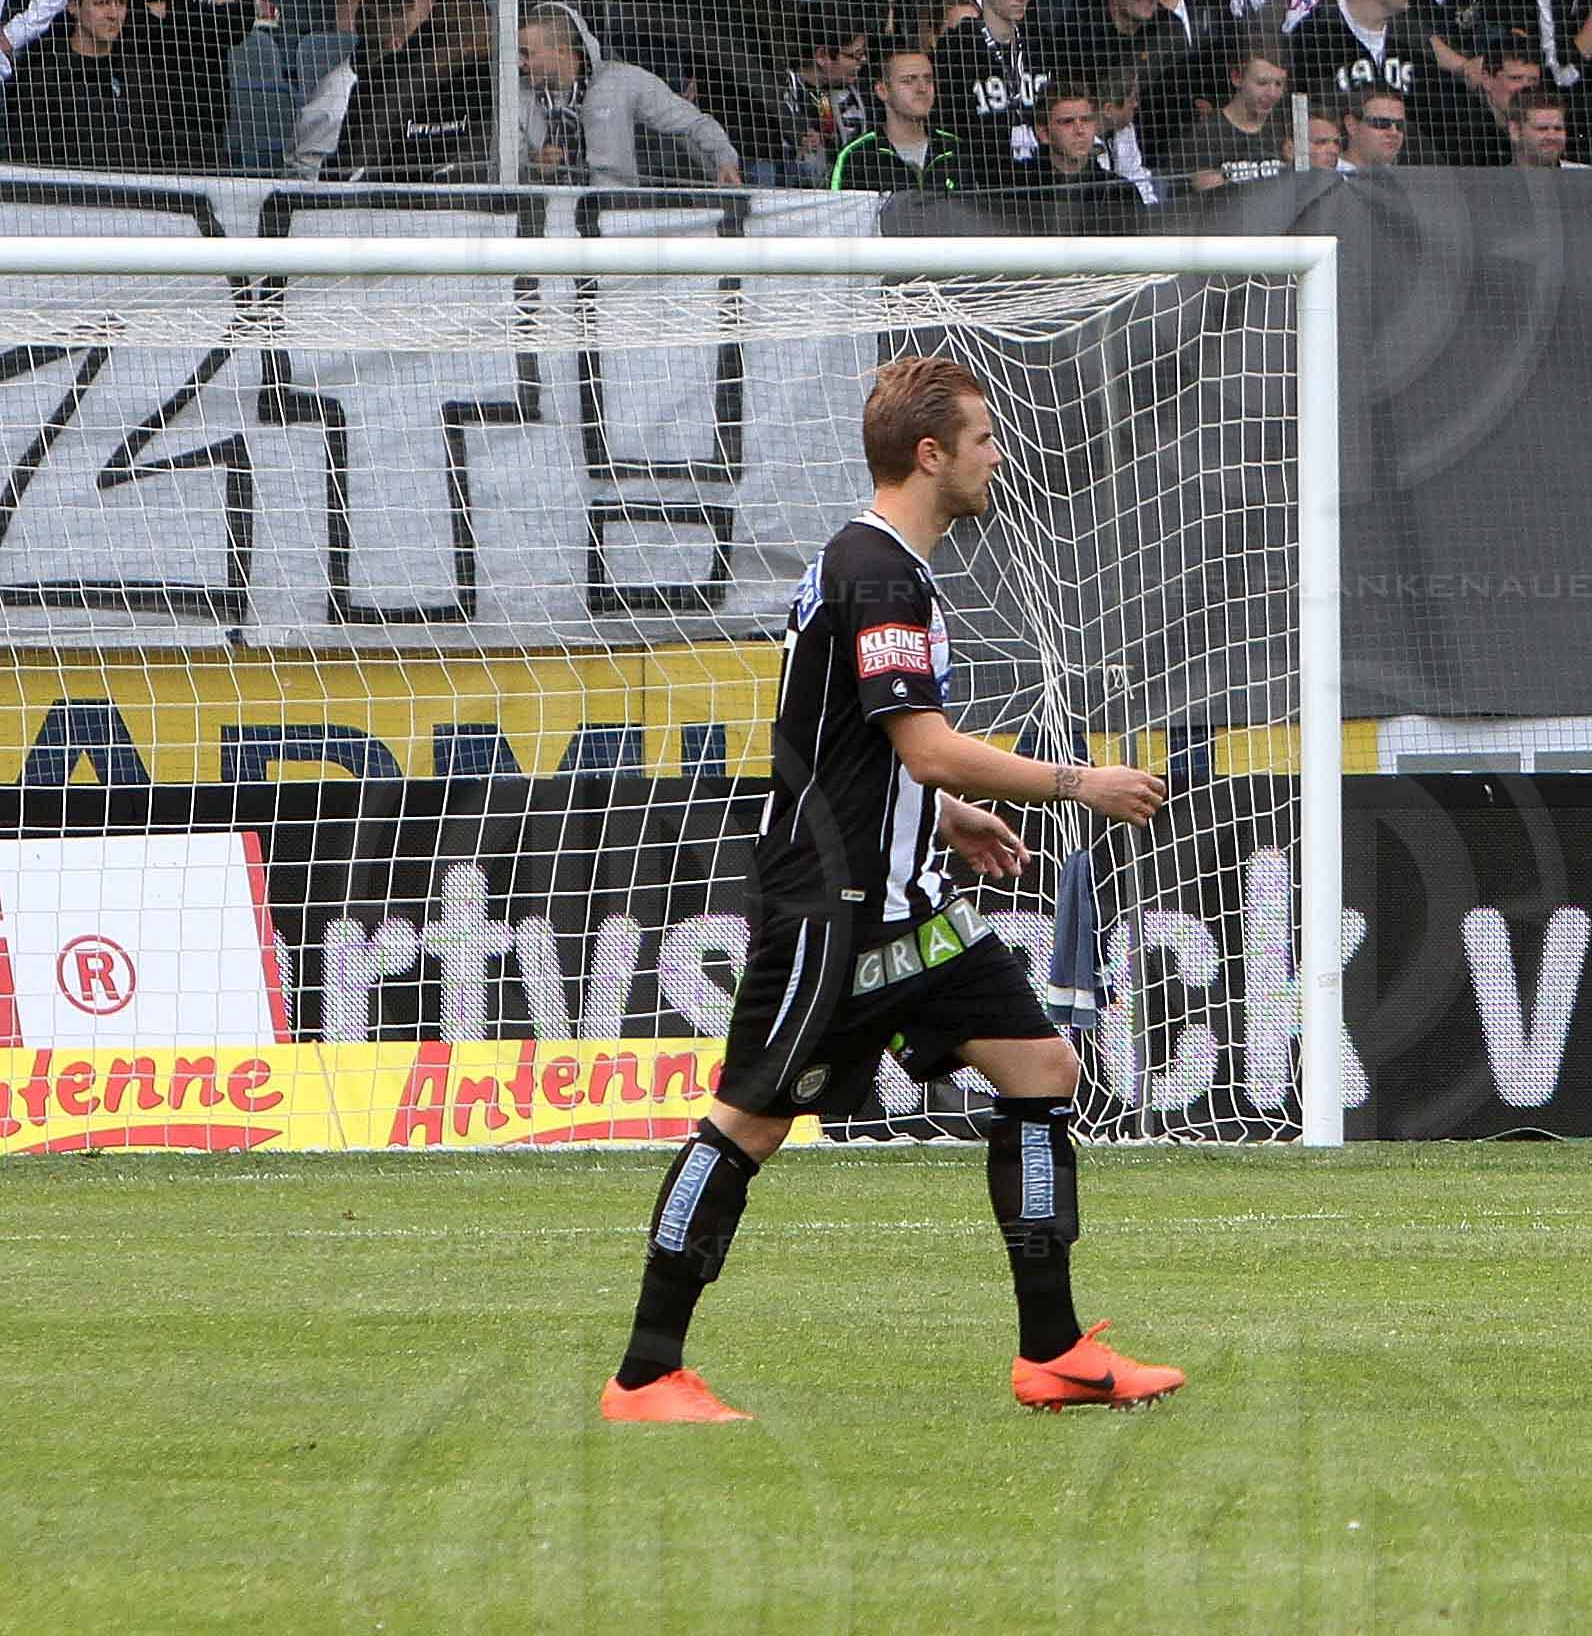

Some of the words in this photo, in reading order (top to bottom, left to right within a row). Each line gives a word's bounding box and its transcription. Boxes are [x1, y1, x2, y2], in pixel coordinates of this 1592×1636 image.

[859, 627, 927, 655] KLEINE
[861, 649, 928, 676] ZEITUNG
[858, 903, 986, 990] GRAZ
